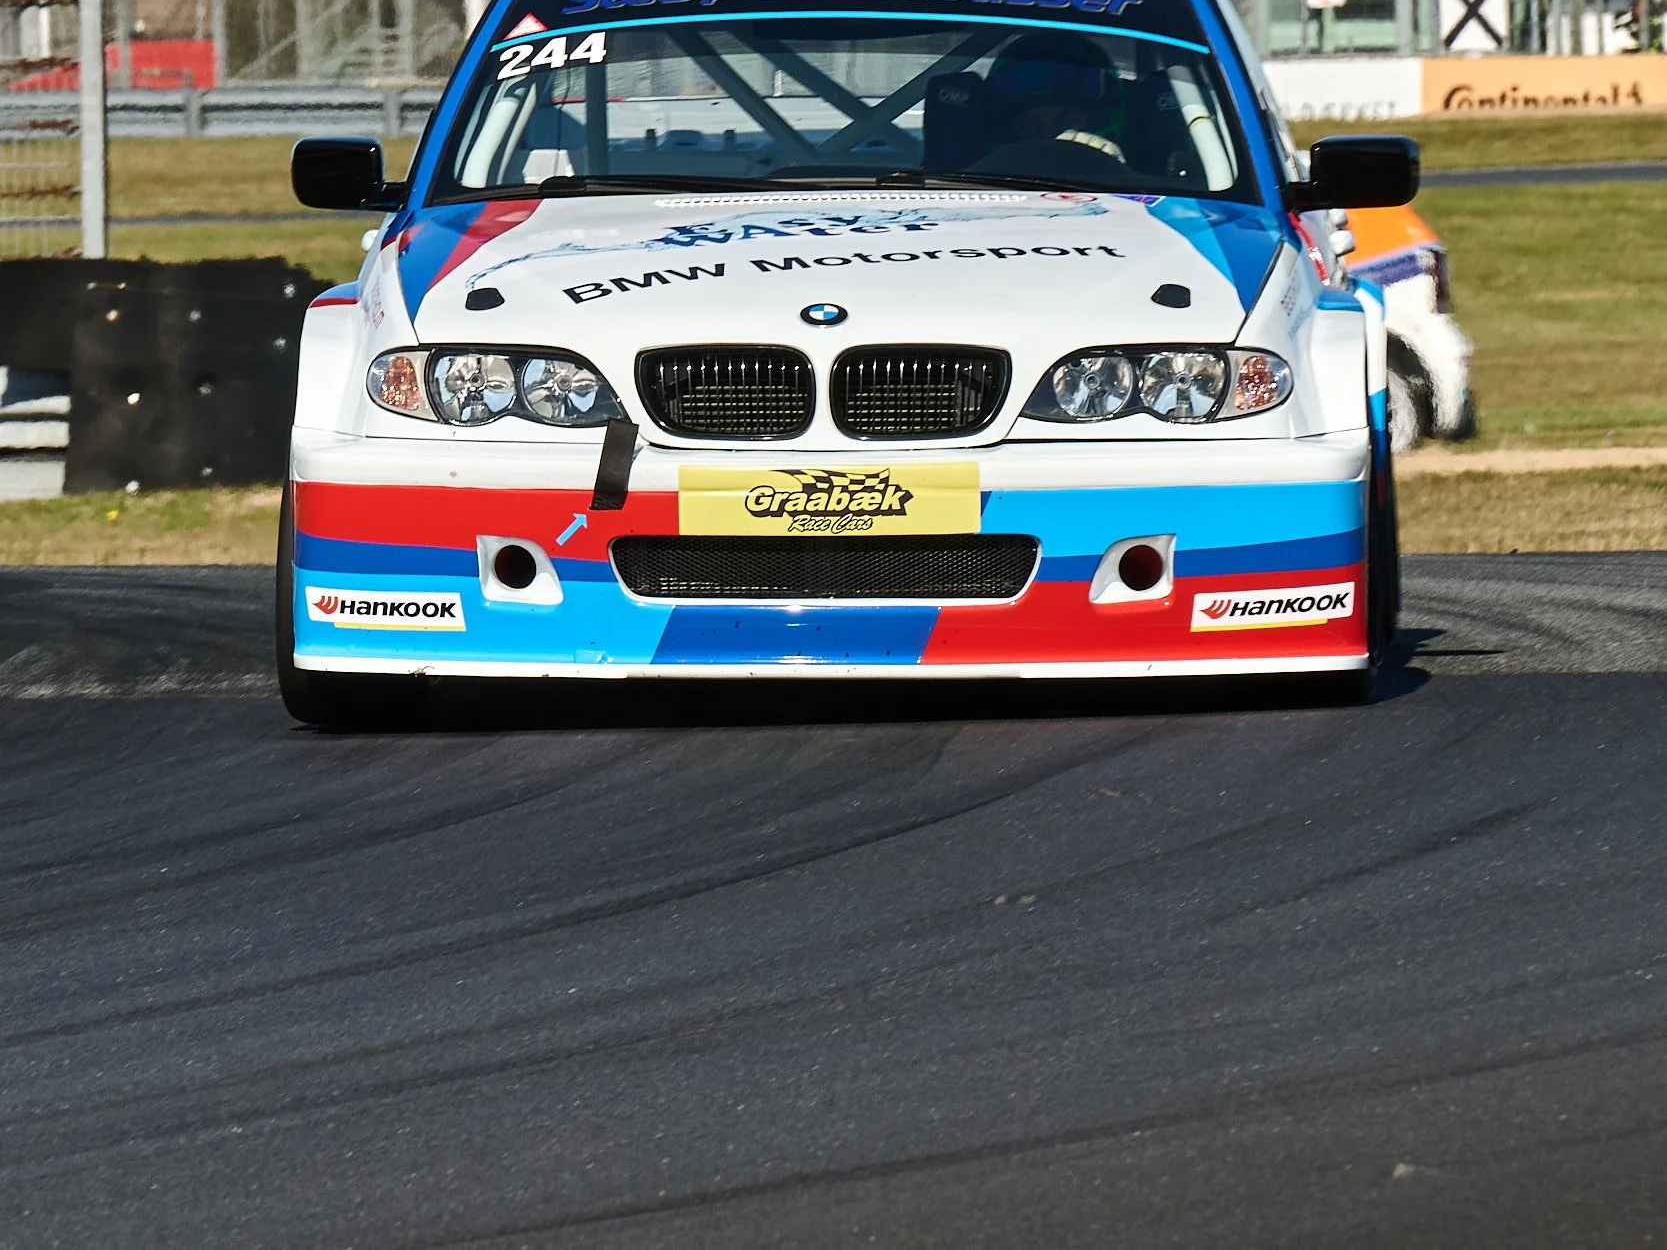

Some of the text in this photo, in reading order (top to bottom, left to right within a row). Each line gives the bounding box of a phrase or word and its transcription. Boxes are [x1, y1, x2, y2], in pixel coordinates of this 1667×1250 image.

[497, 31, 607, 81] 244
[563, 243, 1127, 304] BMW Motorsport
[745, 484, 912, 517] Graabæk
[788, 513, 873, 534] Race Cars
